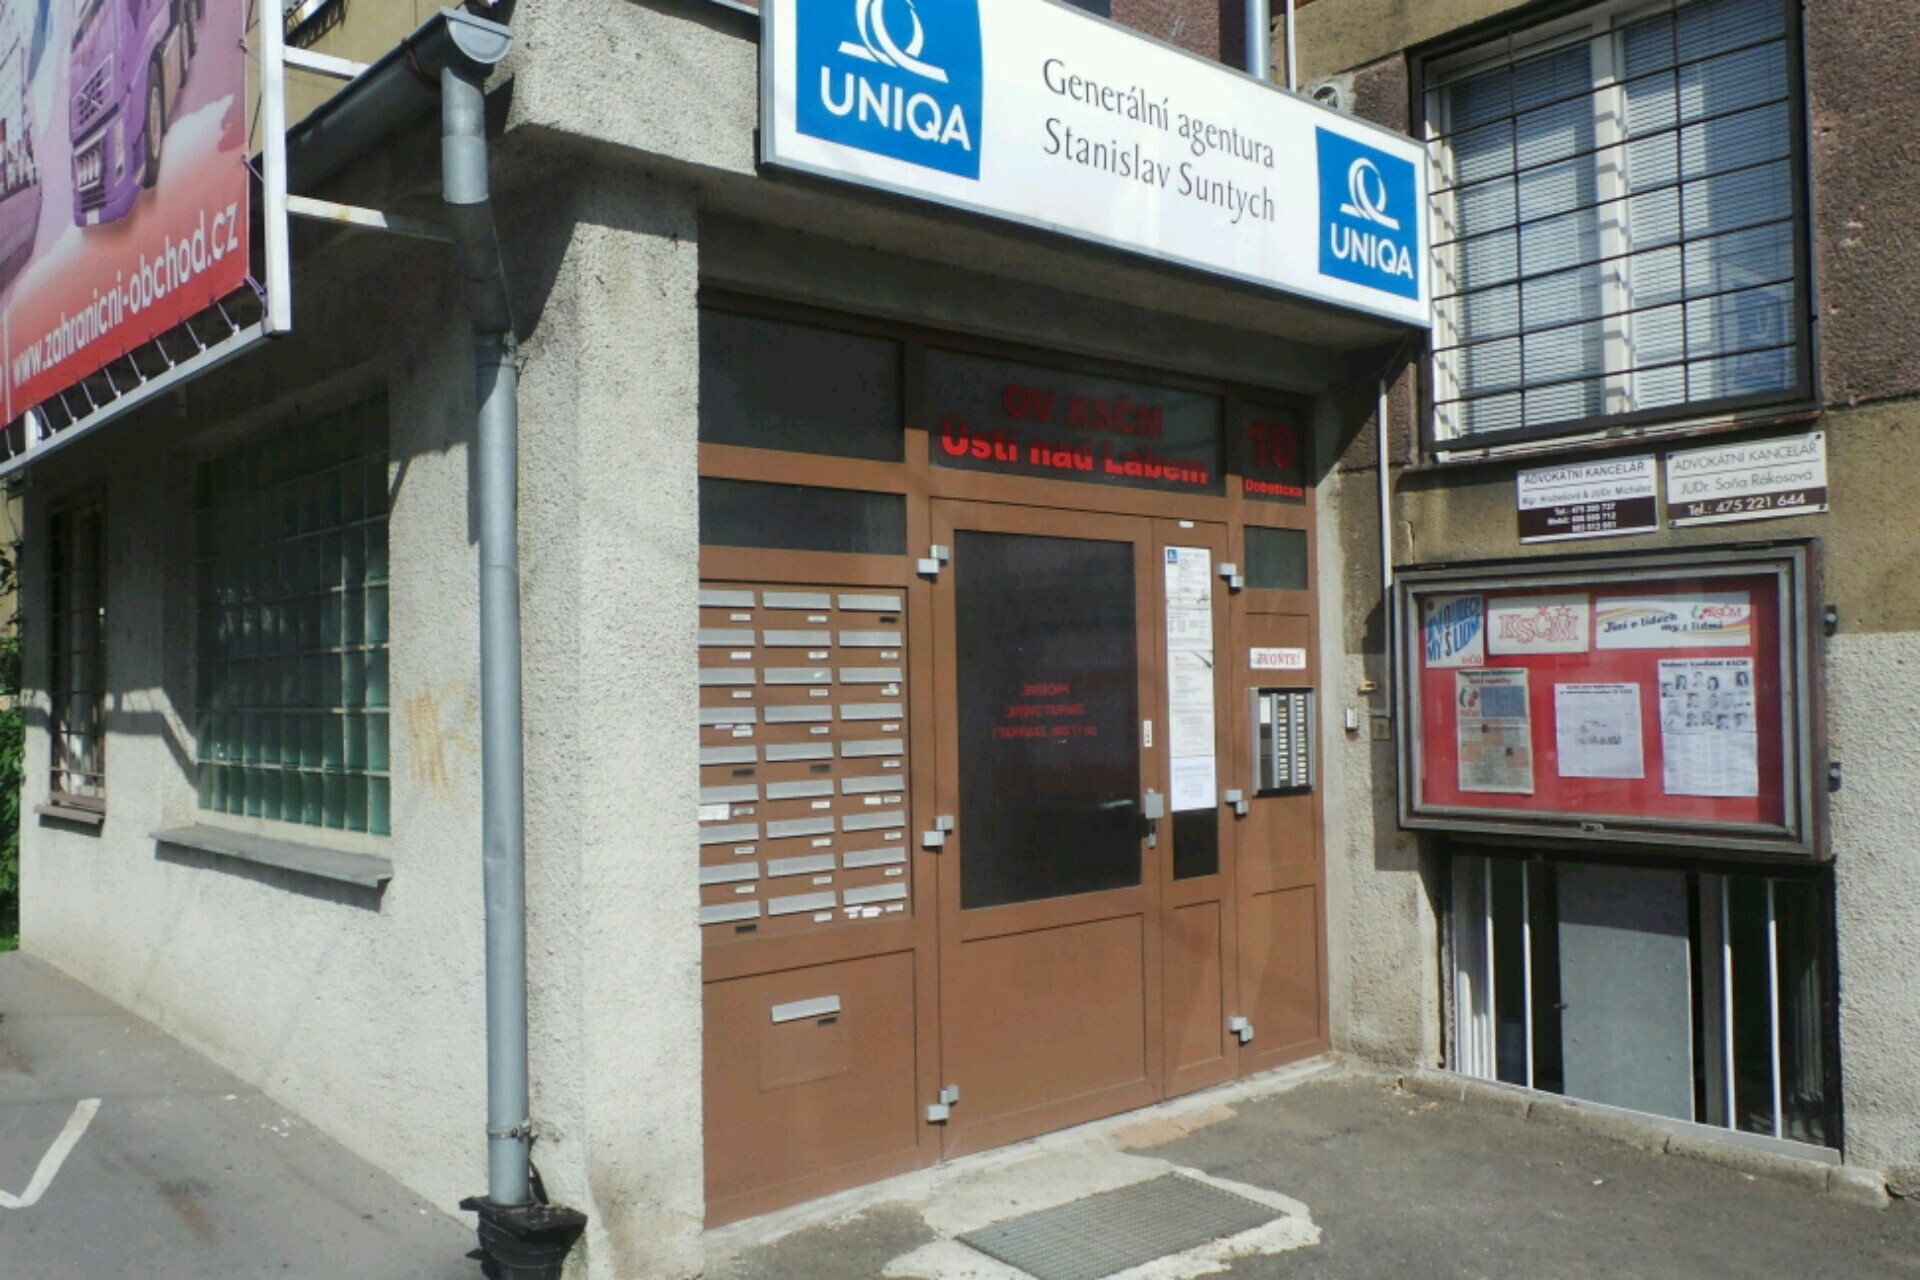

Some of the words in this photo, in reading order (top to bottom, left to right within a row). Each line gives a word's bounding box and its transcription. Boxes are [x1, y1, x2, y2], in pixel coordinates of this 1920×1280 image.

[821, 65, 971, 151] UNIQA
[1043, 58, 1169, 132] Generální
[1178, 113, 1275, 169] agentura
[1043, 117, 1171, 189] Stanislav
[1178, 161, 1276, 225] Suntych
[1331, 222, 1414, 280] UNIQA
[12, 202, 240, 388] www.zahranicni-obchod.cz
[1030, 438, 1093, 472] nad
[1105, 443, 1208, 485] Labem
[1248, 418, 1296, 469] 10
[1680, 481, 1711, 495] JUDr.
[1715, 499, 1743, 513] 475
[1747, 495, 1771, 510] 221
[1776, 492, 1806, 506] 644
